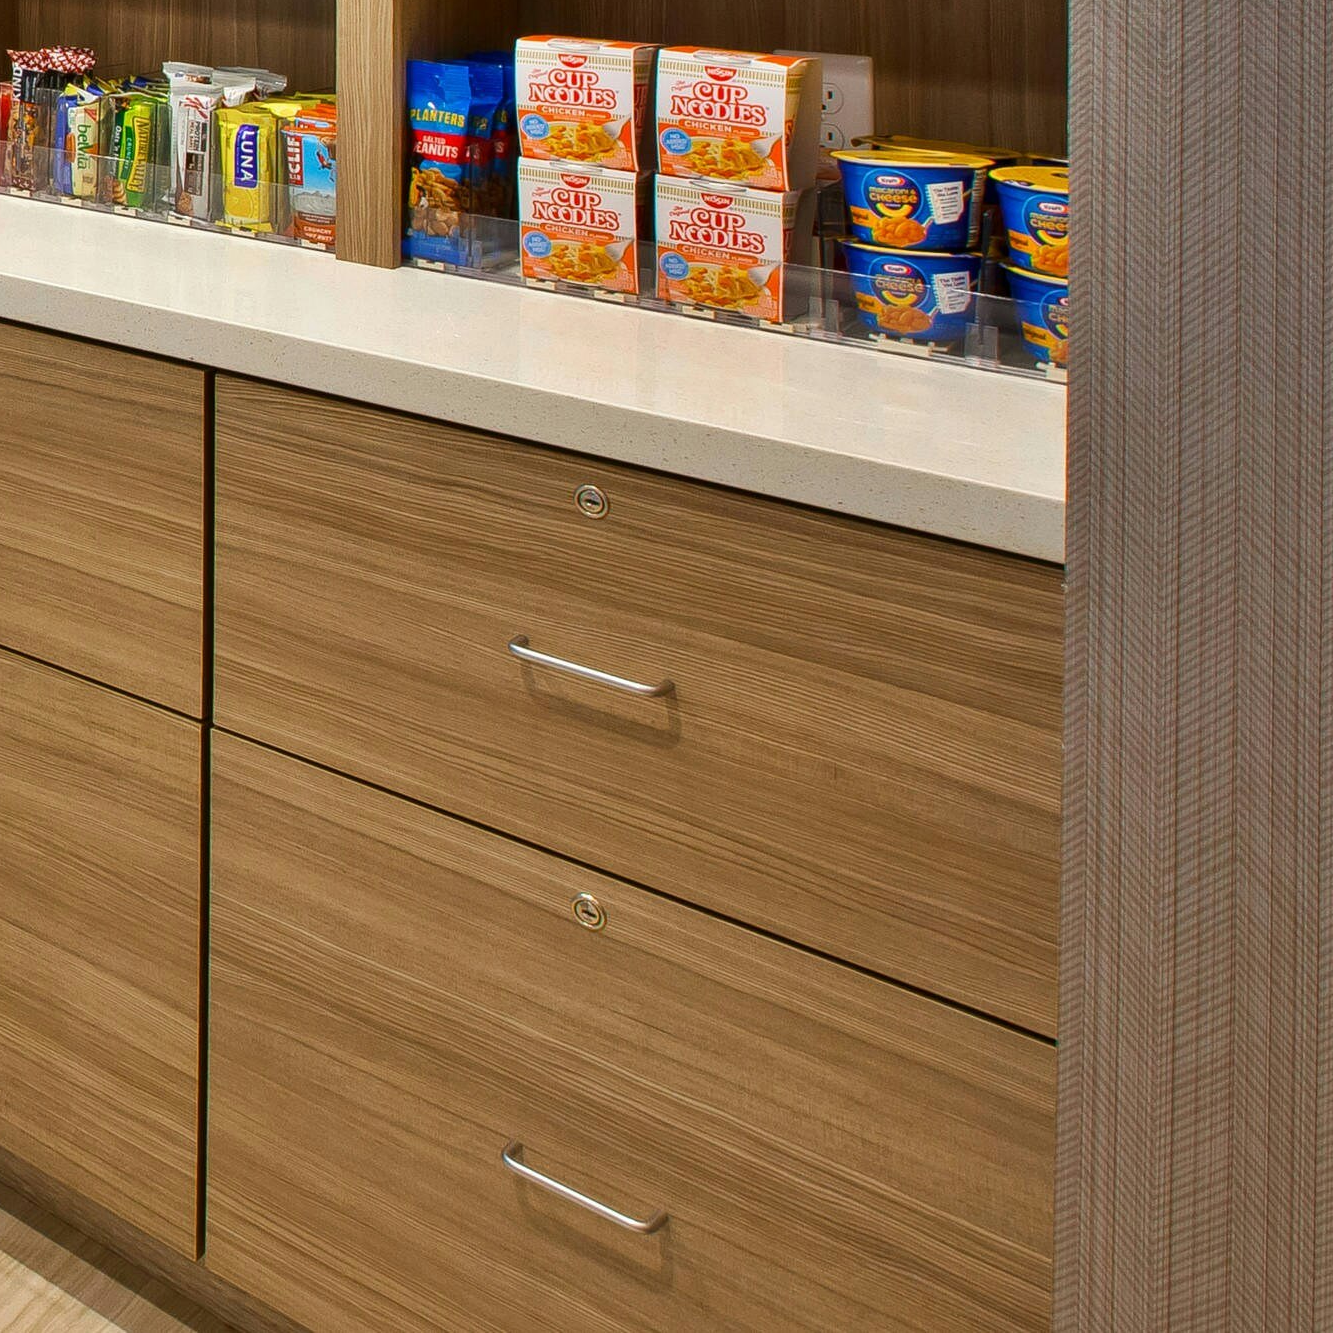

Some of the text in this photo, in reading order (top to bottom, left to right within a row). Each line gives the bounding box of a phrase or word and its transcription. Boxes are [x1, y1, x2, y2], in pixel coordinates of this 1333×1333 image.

[12, 65, 23, 100] KIND
[549, 69, 599, 87] CUP
[528, 84, 618, 109] NOODLES
[694, 81, 748, 103] CUP
[410, 107, 465, 128] PLANTERS
[541, 105, 586, 117] CHICKEN
[671, 95, 767, 127] NOODLES
[135, 116, 151, 153] NATURE
[684, 120, 732, 133] CHICKEN
[240, 130, 255, 182] LUNA
[287, 136, 302, 174] CLIF
[551, 188, 601, 207] CUP
[532, 201, 620, 231] NOODLES
[691, 207, 746, 231] CUP
[544, 225, 589, 237] CHICKEN
[670, 220, 765, 254] NOODLES
[682, 245, 730, 259] CHICKEN
